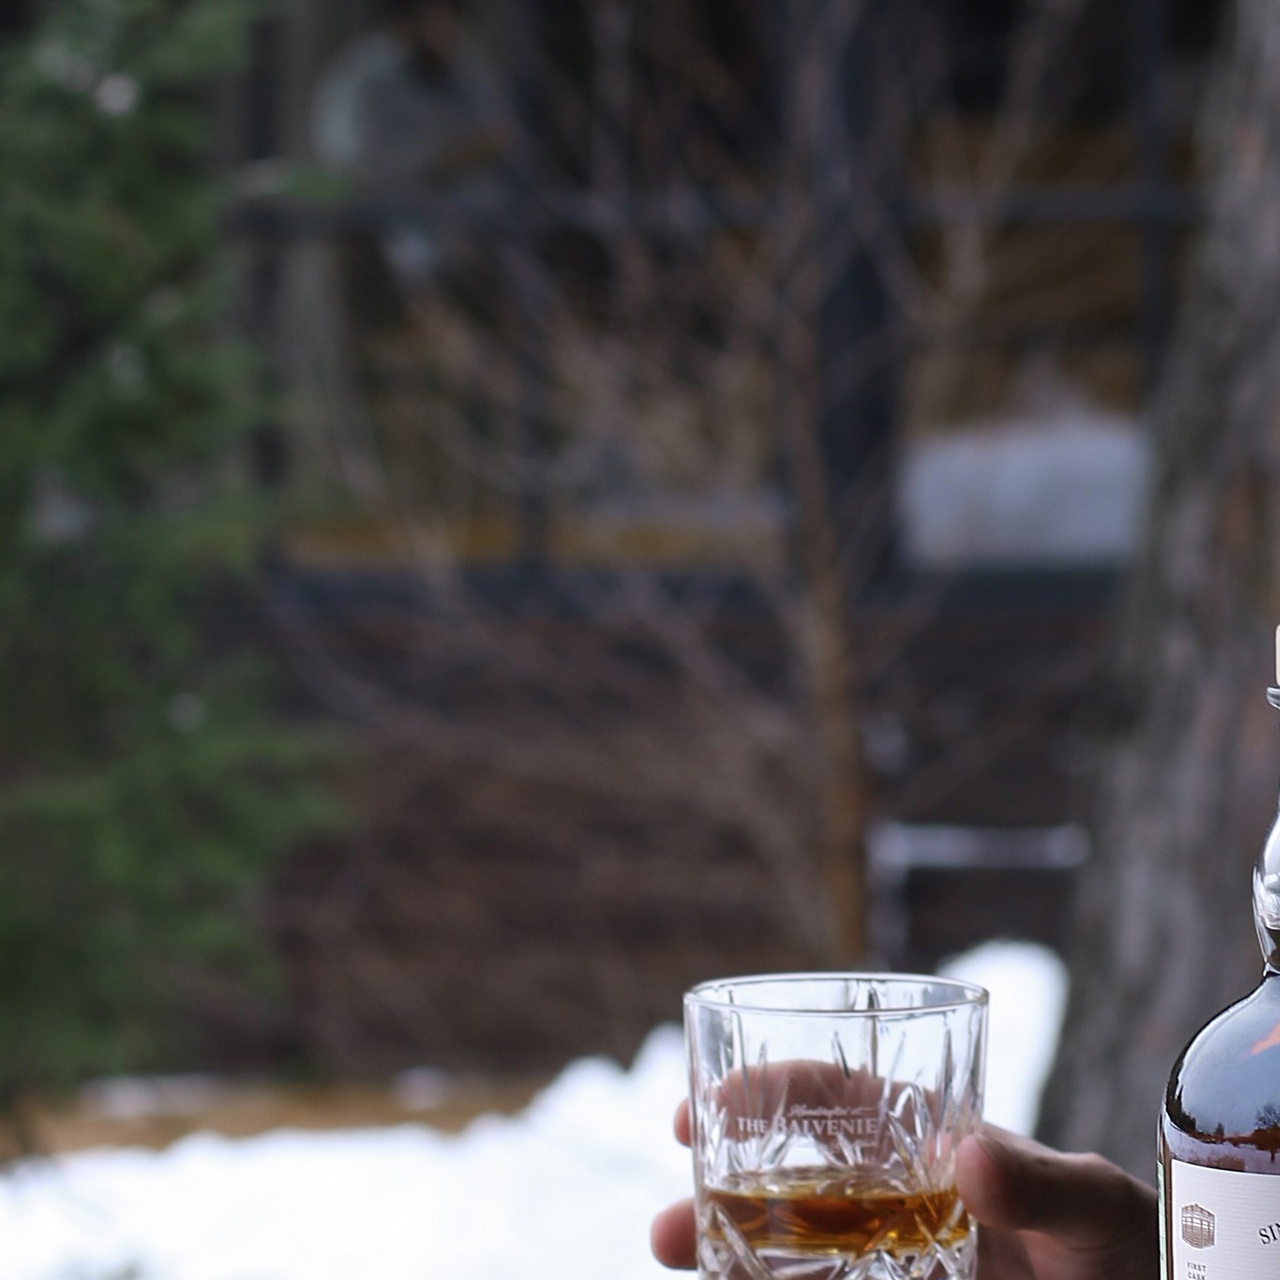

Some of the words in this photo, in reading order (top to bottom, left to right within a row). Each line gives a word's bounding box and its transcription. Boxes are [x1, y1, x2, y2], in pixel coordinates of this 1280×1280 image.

[736, 1117, 768, 1133] THE
[773, 1116, 878, 1135] BALVENIE
[1186, 1261, 1207, 1272] FIRST
